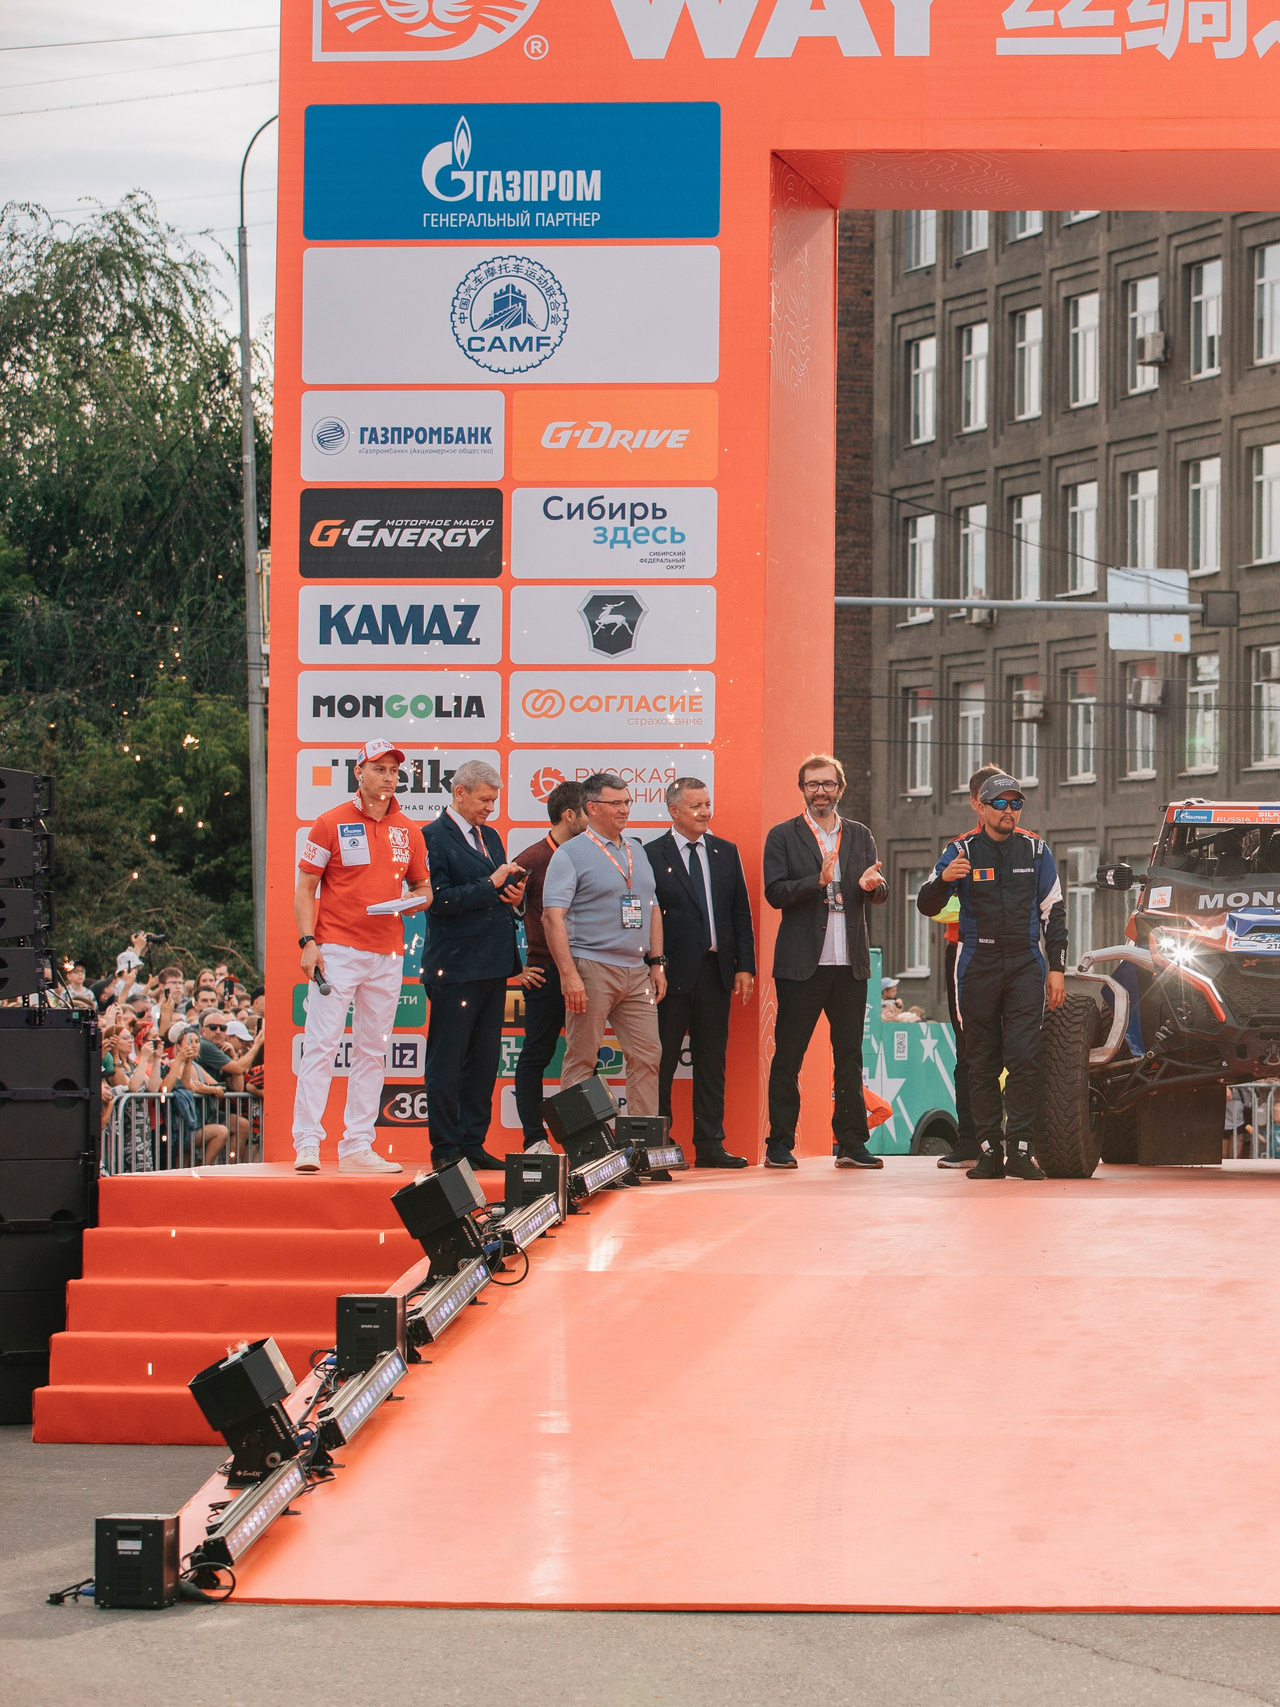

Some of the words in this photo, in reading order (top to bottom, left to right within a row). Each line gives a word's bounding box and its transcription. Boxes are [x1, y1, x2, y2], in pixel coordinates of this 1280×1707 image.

[476, 169, 601, 202] ГАЗПРОМ
[423, 210, 530, 228] ГЕНЕРАЛЬНЫЙ
[535, 212, 601, 227] ПАРТНЕР
[467, 336, 552, 353] CAMF
[359, 426, 493, 445] ГАЗПРОМБАНК
[542, 495, 668, 527] Сибирь
[385, 519, 452, 527] МОТОРНОЕ
[453, 519, 495, 527] МАСЛО
[592, 526, 686, 549] здесь
[639, 556, 686, 564] ФЕДЕРАЛЬНЫЙ
[319, 604, 481, 645] KAMAZ
[312, 694, 486, 719] MONGOLIA
[569, 694, 703, 713] СОГЛАСИЕ
[392, 848, 410, 857] SILK
